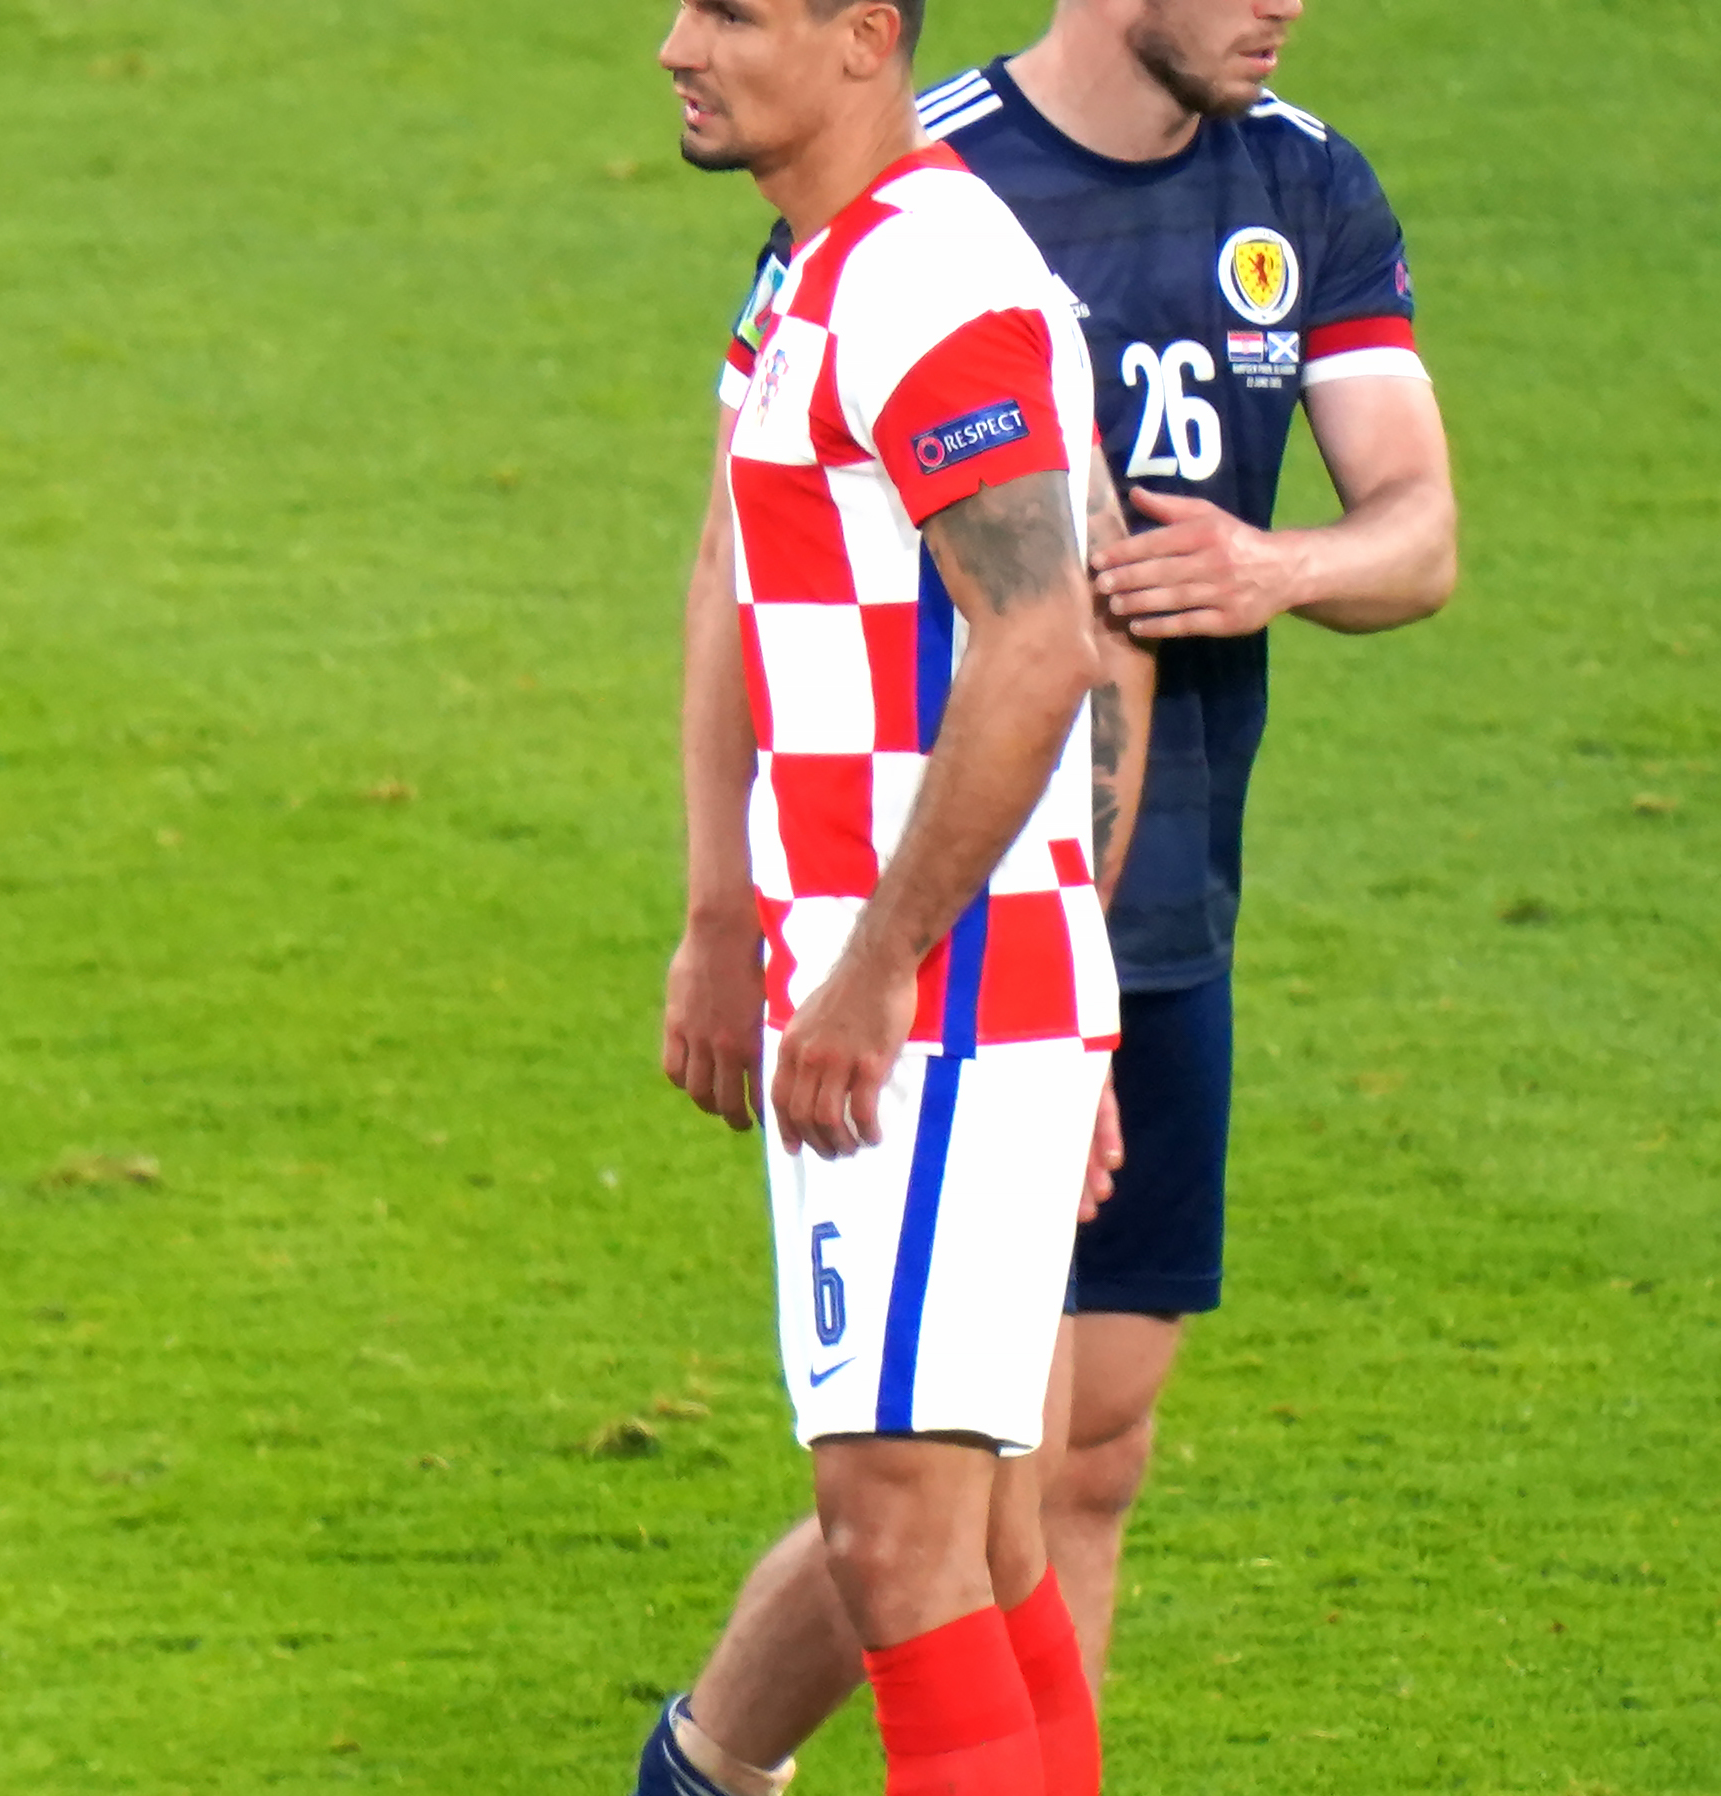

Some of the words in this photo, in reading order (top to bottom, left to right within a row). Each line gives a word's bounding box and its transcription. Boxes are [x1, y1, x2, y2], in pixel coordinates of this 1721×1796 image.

[943, 410, 1022, 452] RESPECT
[1121, 340, 1222, 481] 26
[811, 1221, 846, 1346] 6
